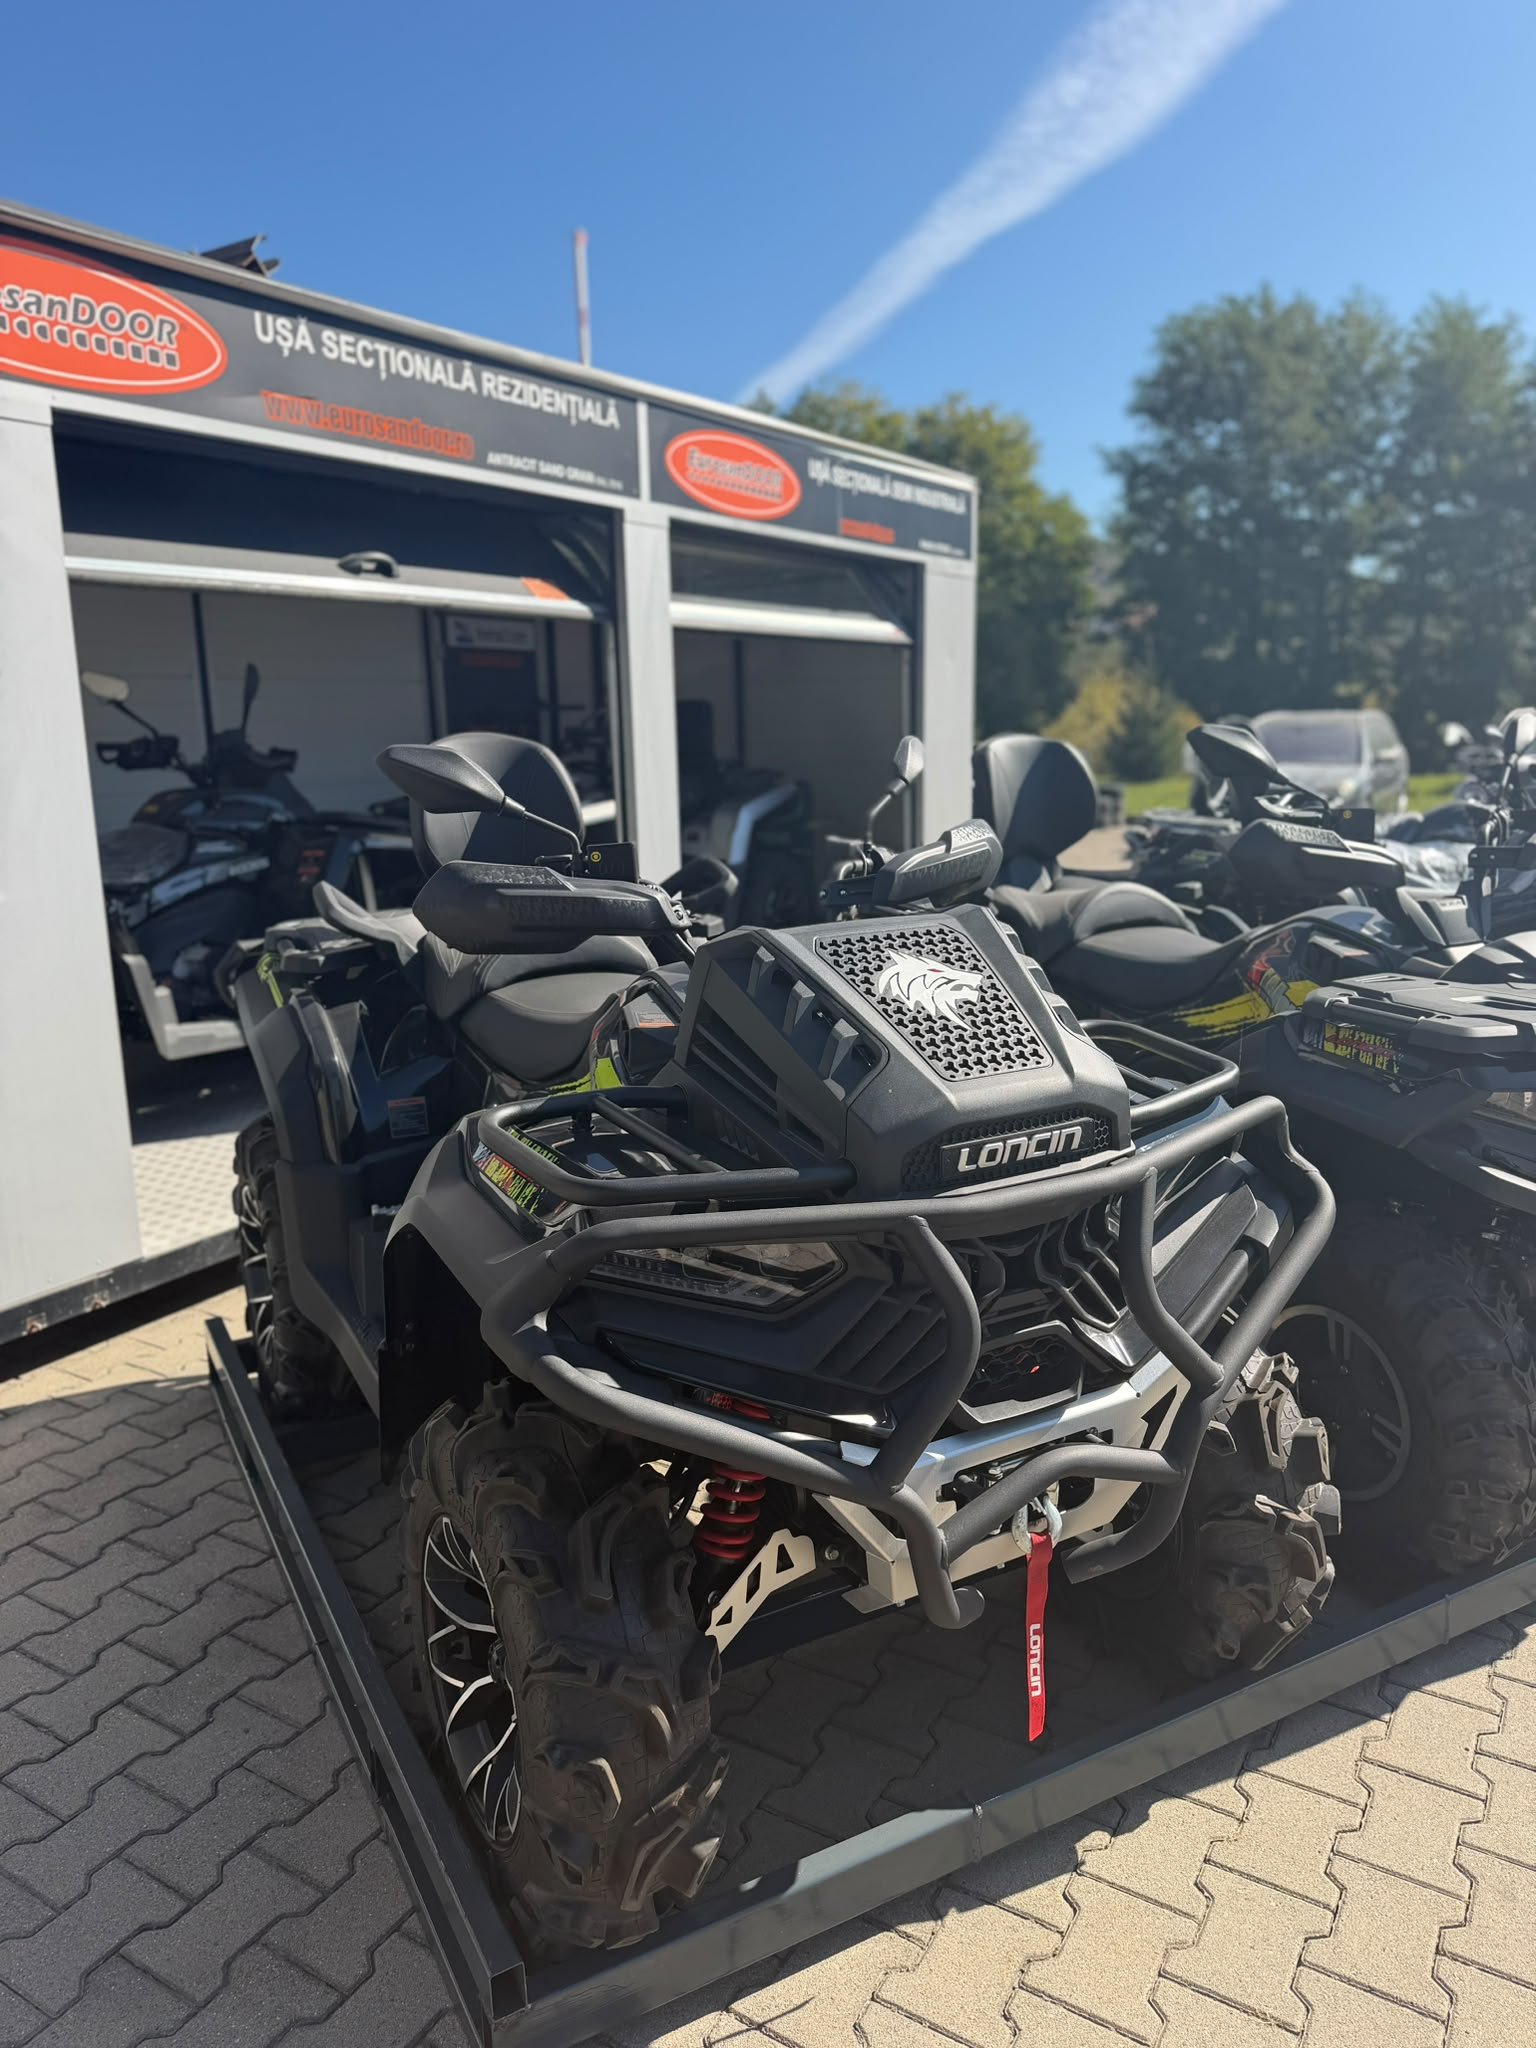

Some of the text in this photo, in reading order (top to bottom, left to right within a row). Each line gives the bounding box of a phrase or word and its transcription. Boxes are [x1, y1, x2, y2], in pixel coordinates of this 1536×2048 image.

[0, 284, 178, 348] sanDOOR
[254, 311, 621, 431] UȘĂ SECȚIONALĂ REZIDENȚIALĂ
[957, 1126, 1082, 1173] LONCIN
[1029, 1623, 1042, 1697] LONCIN
